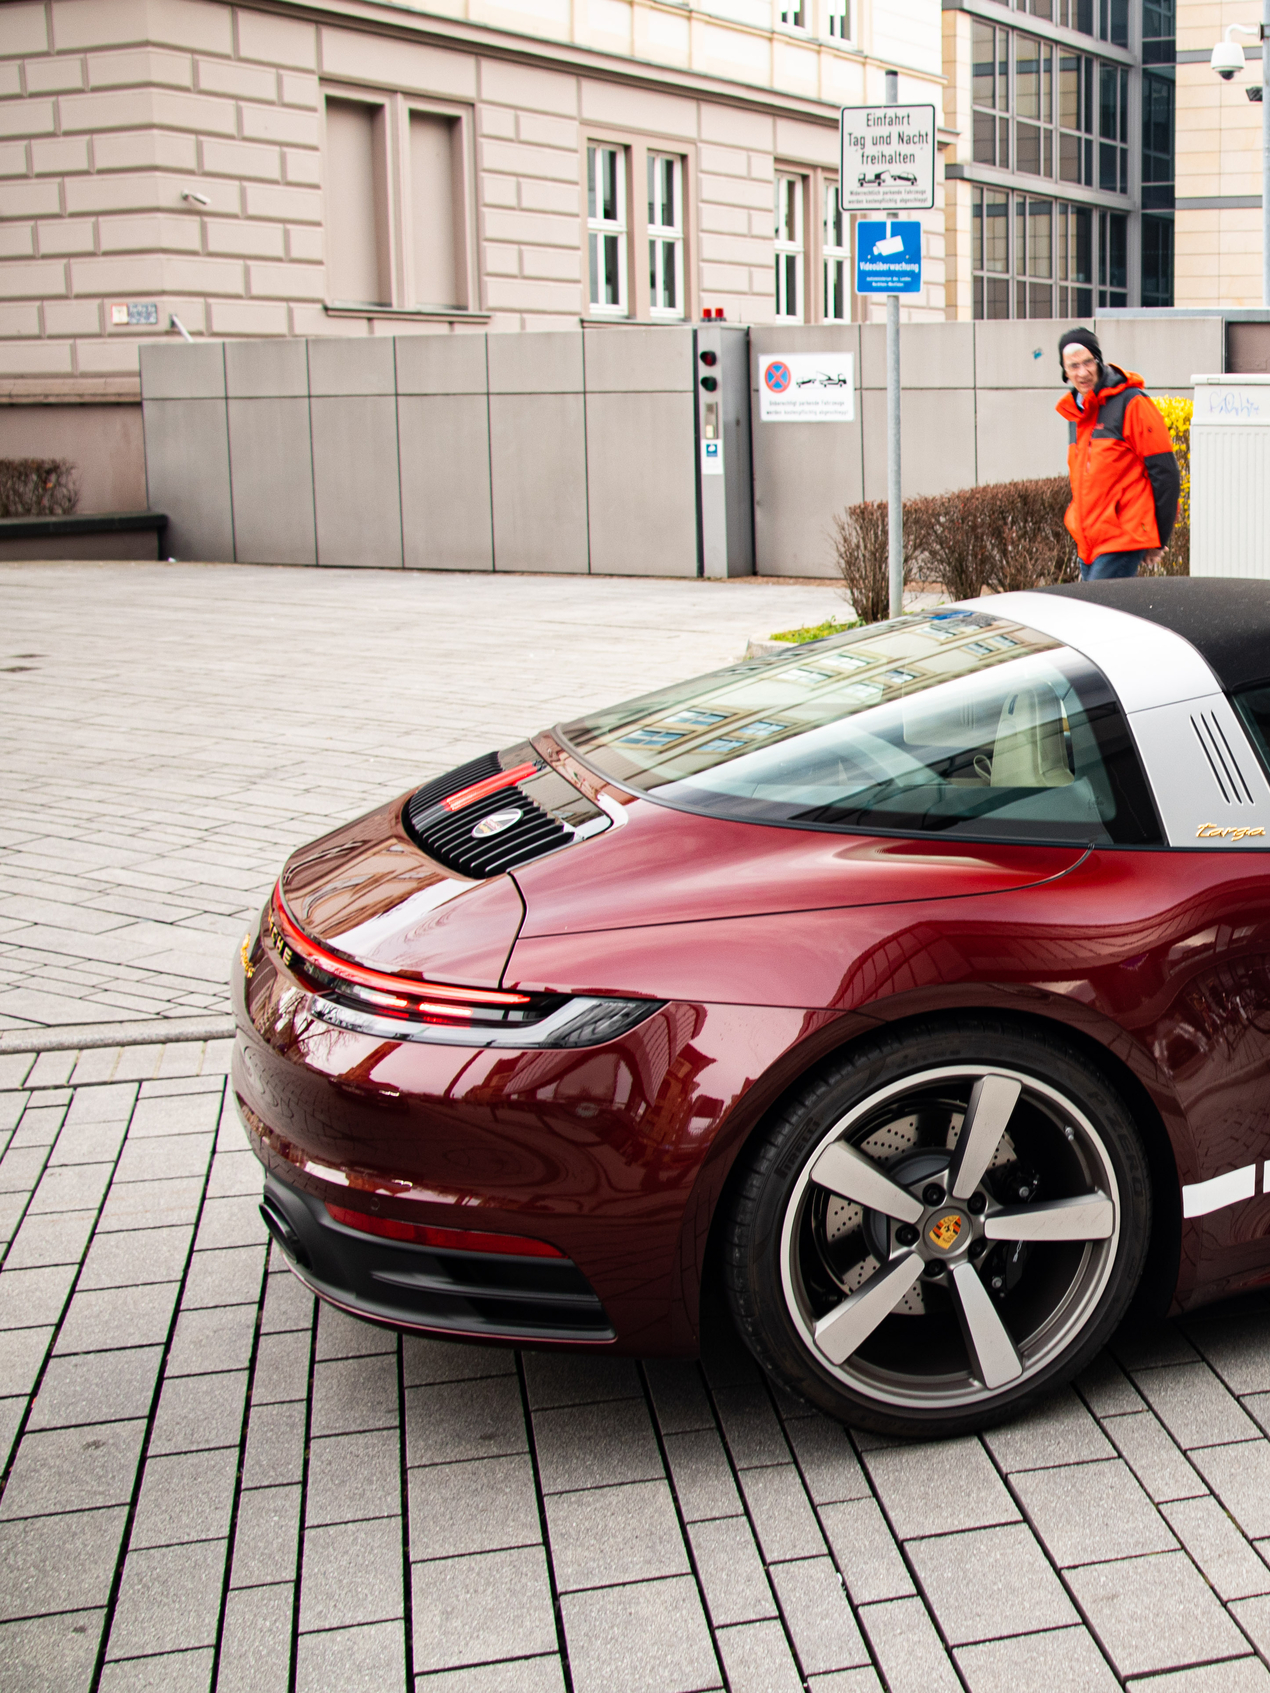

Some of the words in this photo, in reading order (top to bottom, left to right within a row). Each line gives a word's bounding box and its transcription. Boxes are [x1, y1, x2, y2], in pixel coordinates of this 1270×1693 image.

[866, 112, 911, 128] Einfahrt
[848, 132, 866, 150] Tag
[871, 131, 892, 146] und
[897, 130, 929, 145] Nacht
[861, 150, 916, 165] freihalten
[859, 261, 919, 274] Videoüberwachung
[774, 1115, 821, 1180] PIRELLI
